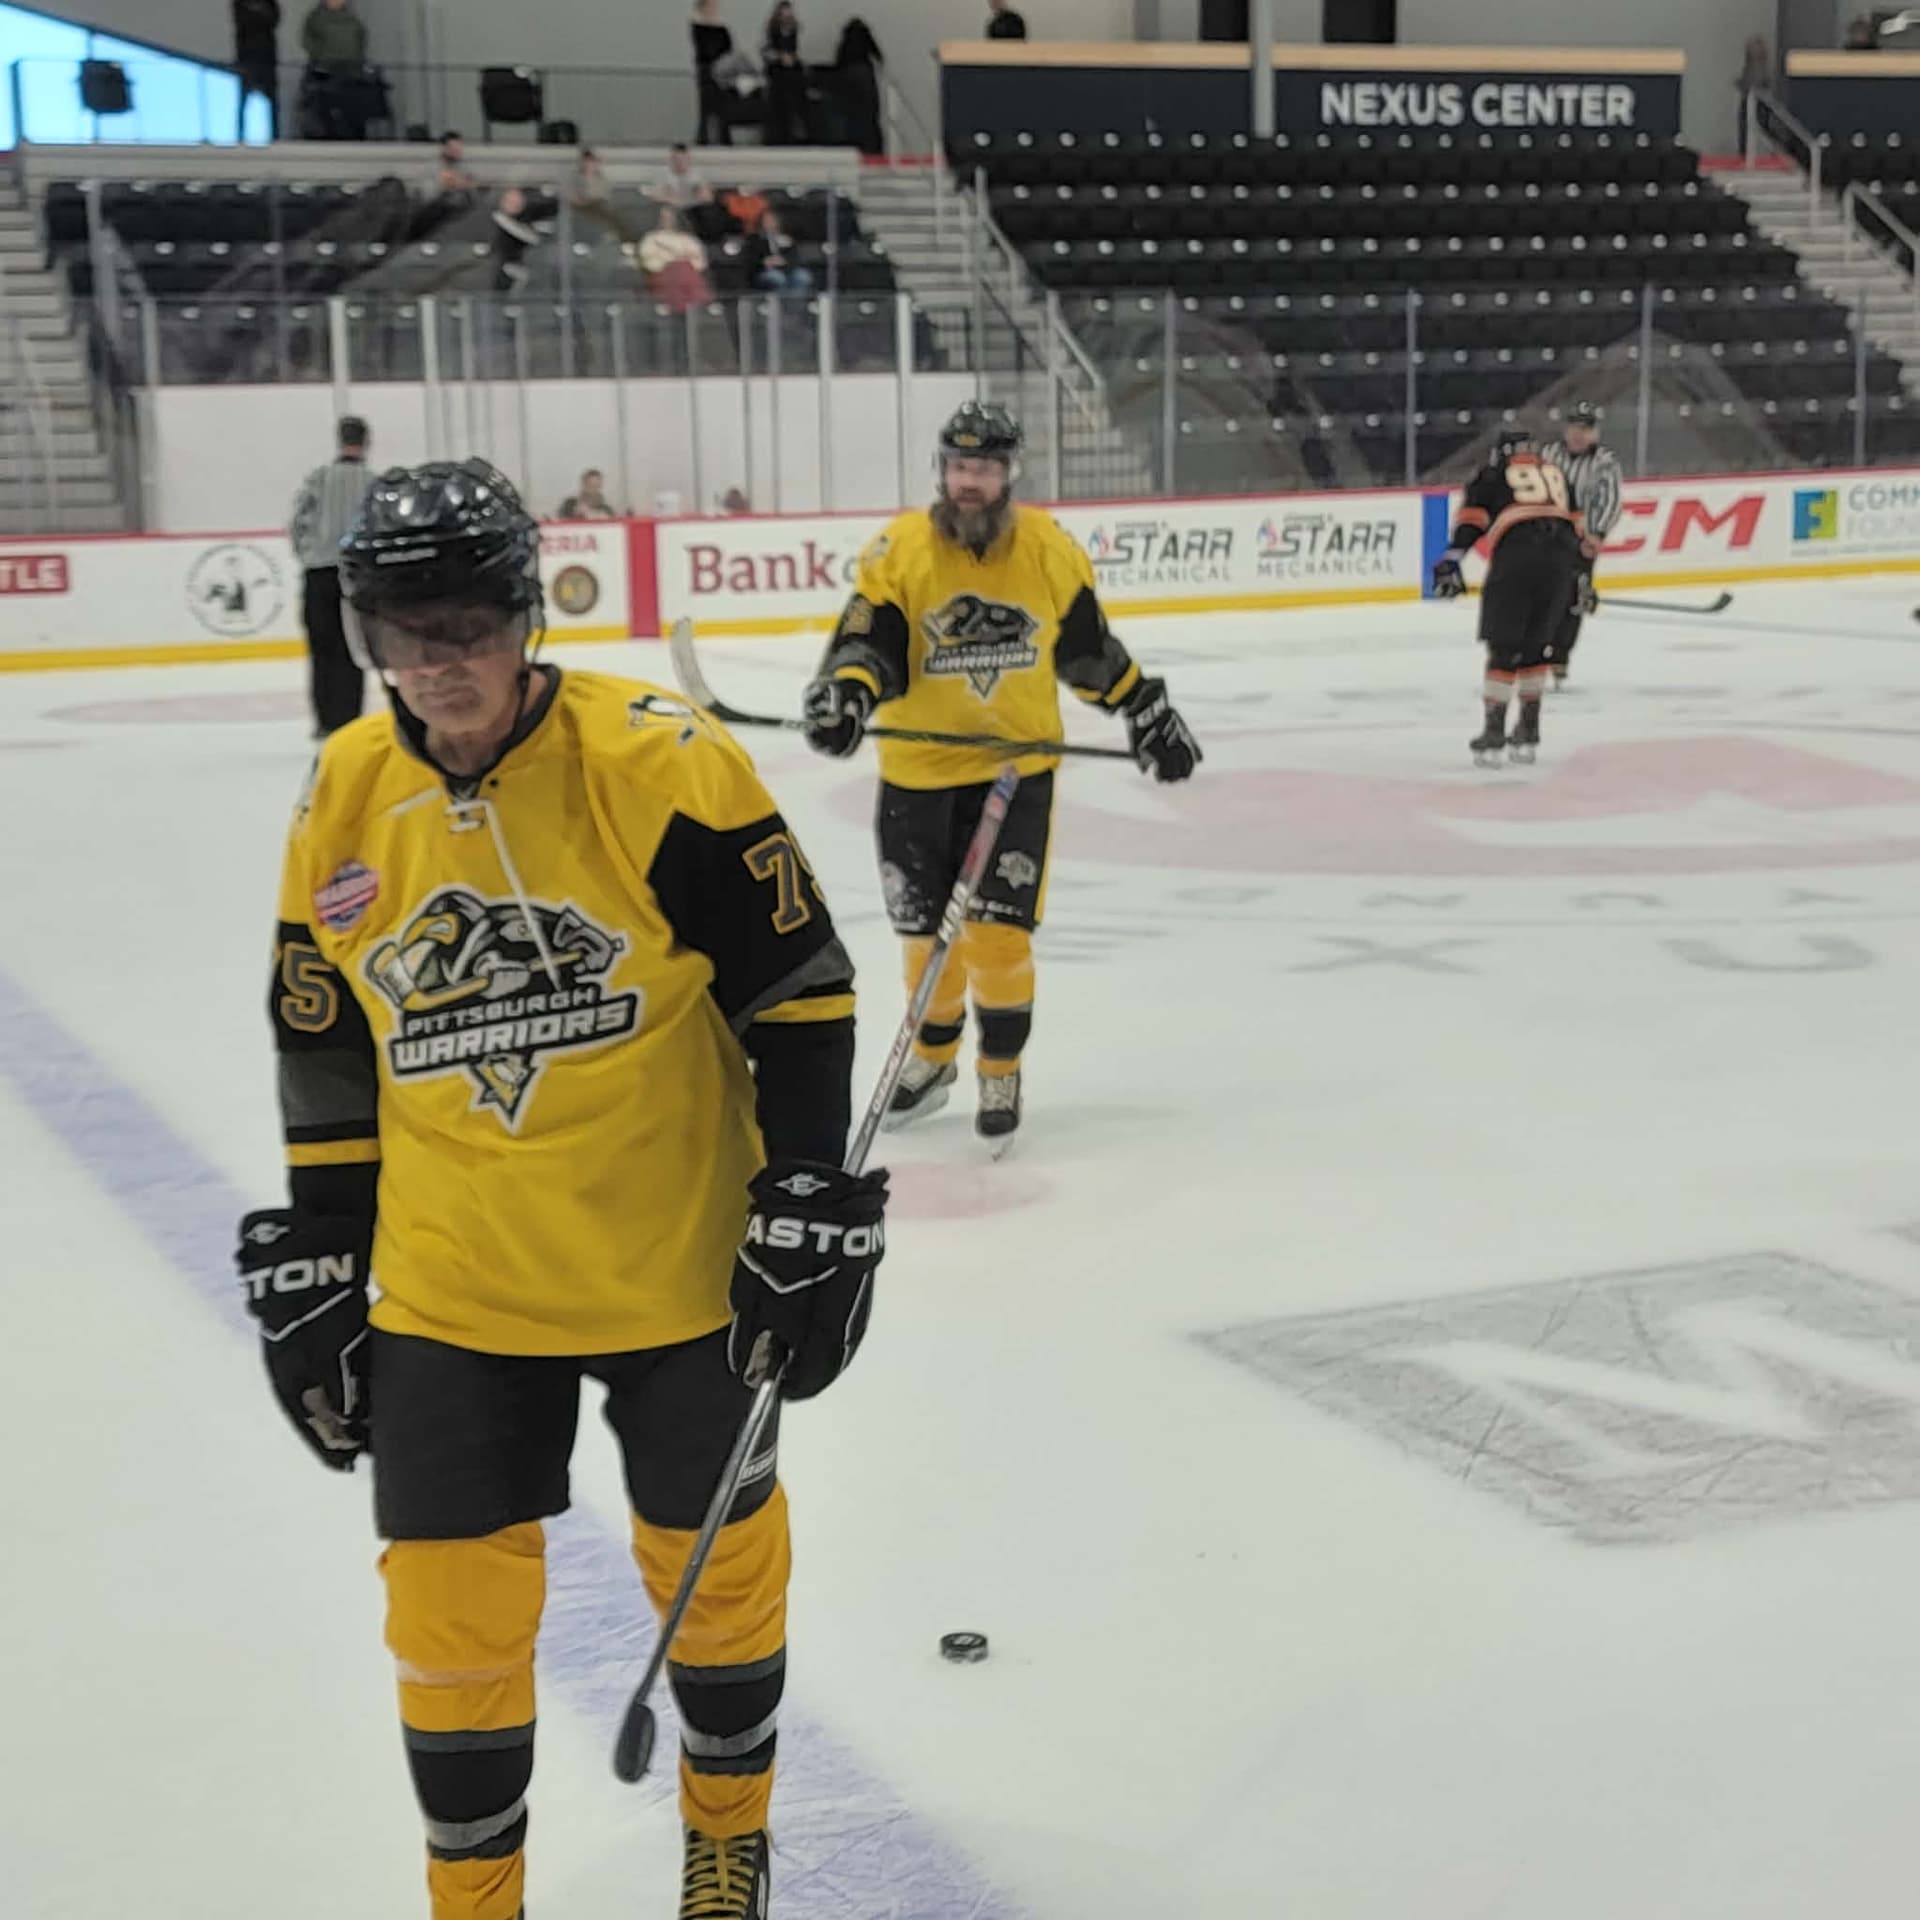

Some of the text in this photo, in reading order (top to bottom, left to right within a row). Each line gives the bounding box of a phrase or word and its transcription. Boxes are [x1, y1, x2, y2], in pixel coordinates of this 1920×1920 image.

[1321, 83, 1634, 127] NEXUS CENTER
[1093, 529, 1233, 565] STARR
[1256, 519, 1396, 558] STARR
[1256, 556, 1395, 578] MECHANICAL
[406, 988, 594, 1036] PITTSBURGH
[393, 1000, 629, 1072] WARRIORS
